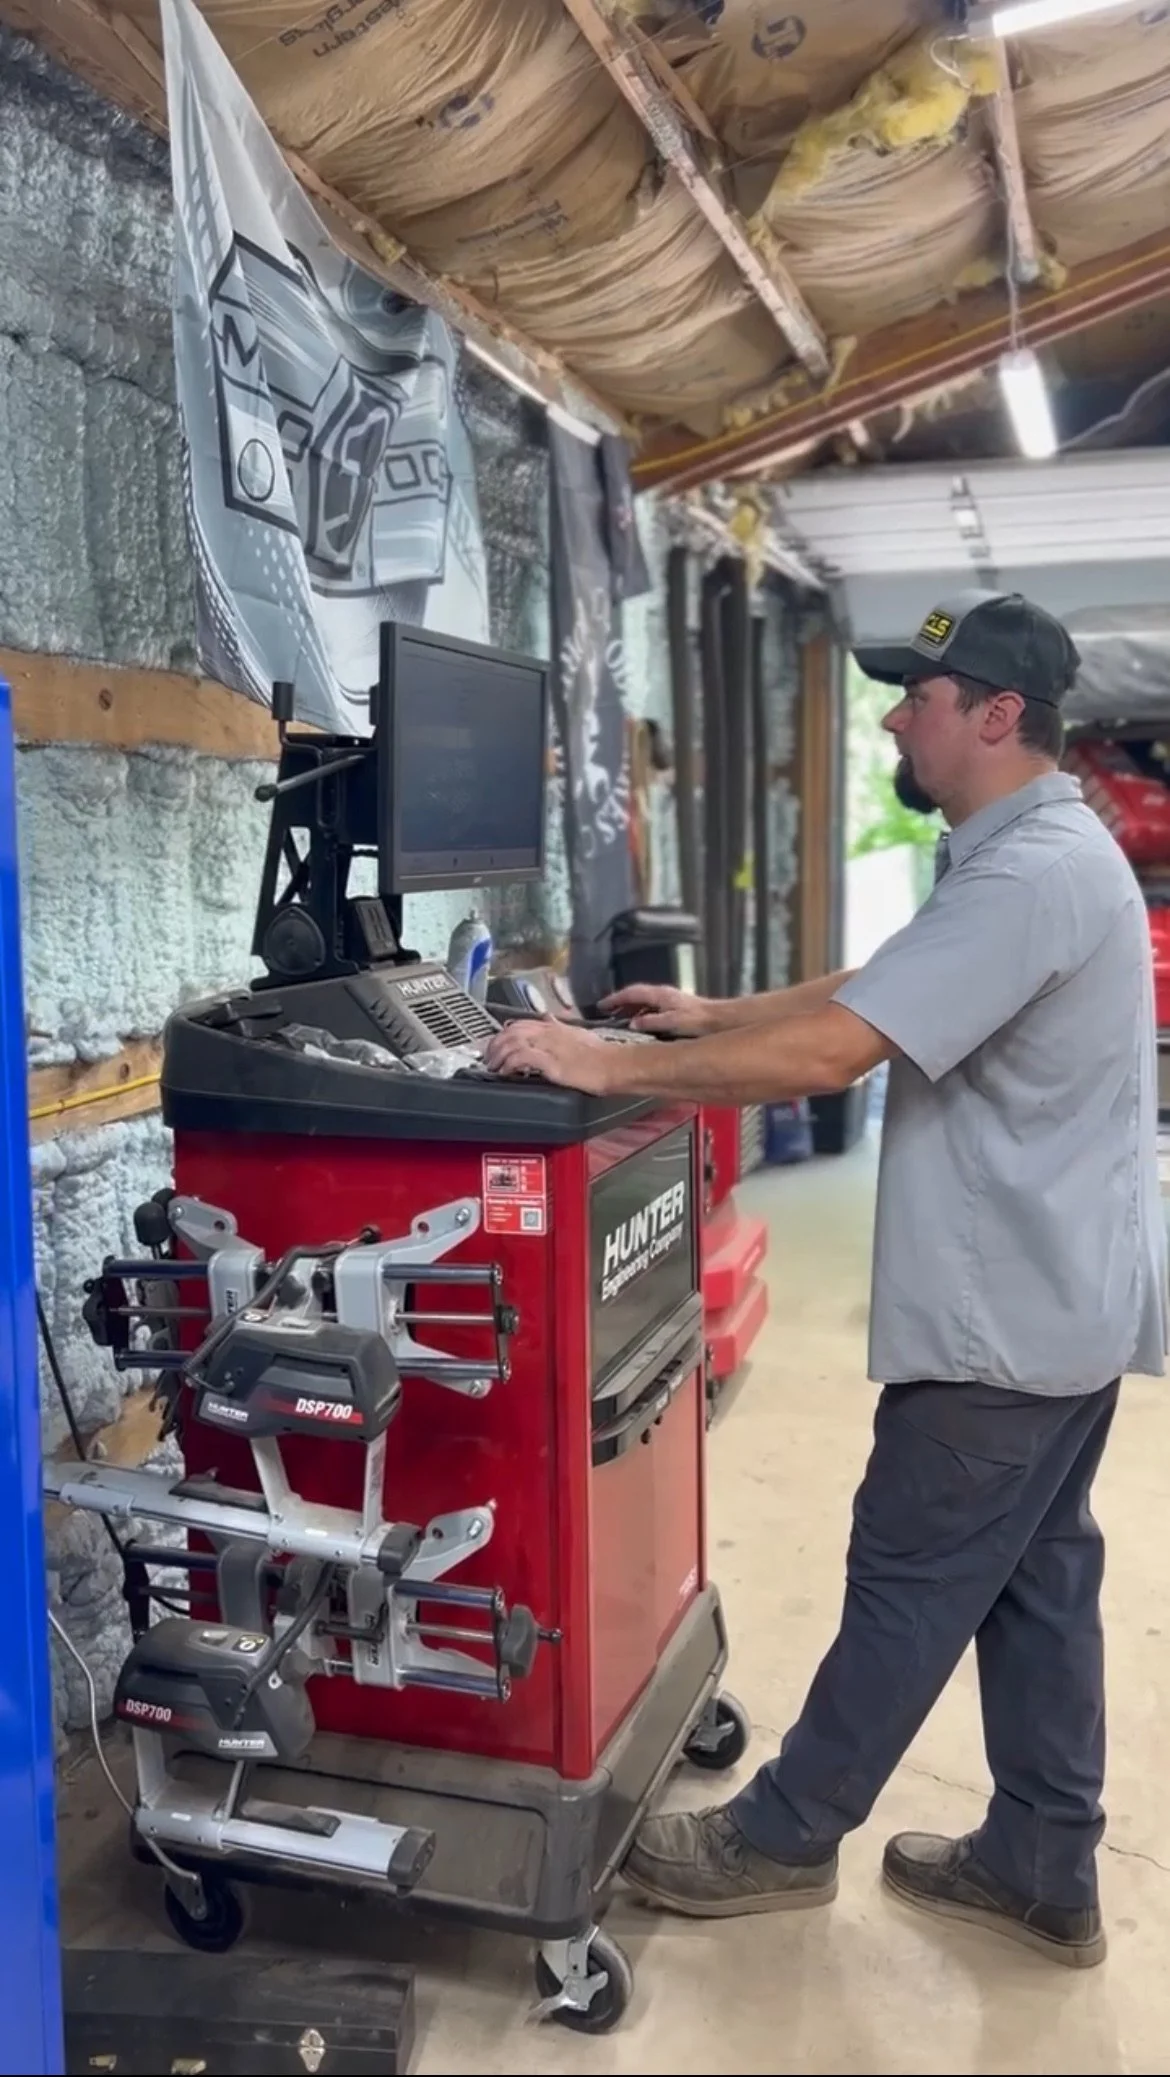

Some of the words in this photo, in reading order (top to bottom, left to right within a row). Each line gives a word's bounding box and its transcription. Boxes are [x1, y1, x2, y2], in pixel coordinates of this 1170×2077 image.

[603, 1180, 685, 1277] HUNTER
[601, 1250, 650, 1302] Engineering
[650, 1221, 685, 1260] Company
[207, 1402, 249, 1420] HUNTER
[295, 1398, 353, 1420] DSP700
[125, 1699, 172, 1722] DSP700
[218, 1738, 265, 1748] HUNTER
